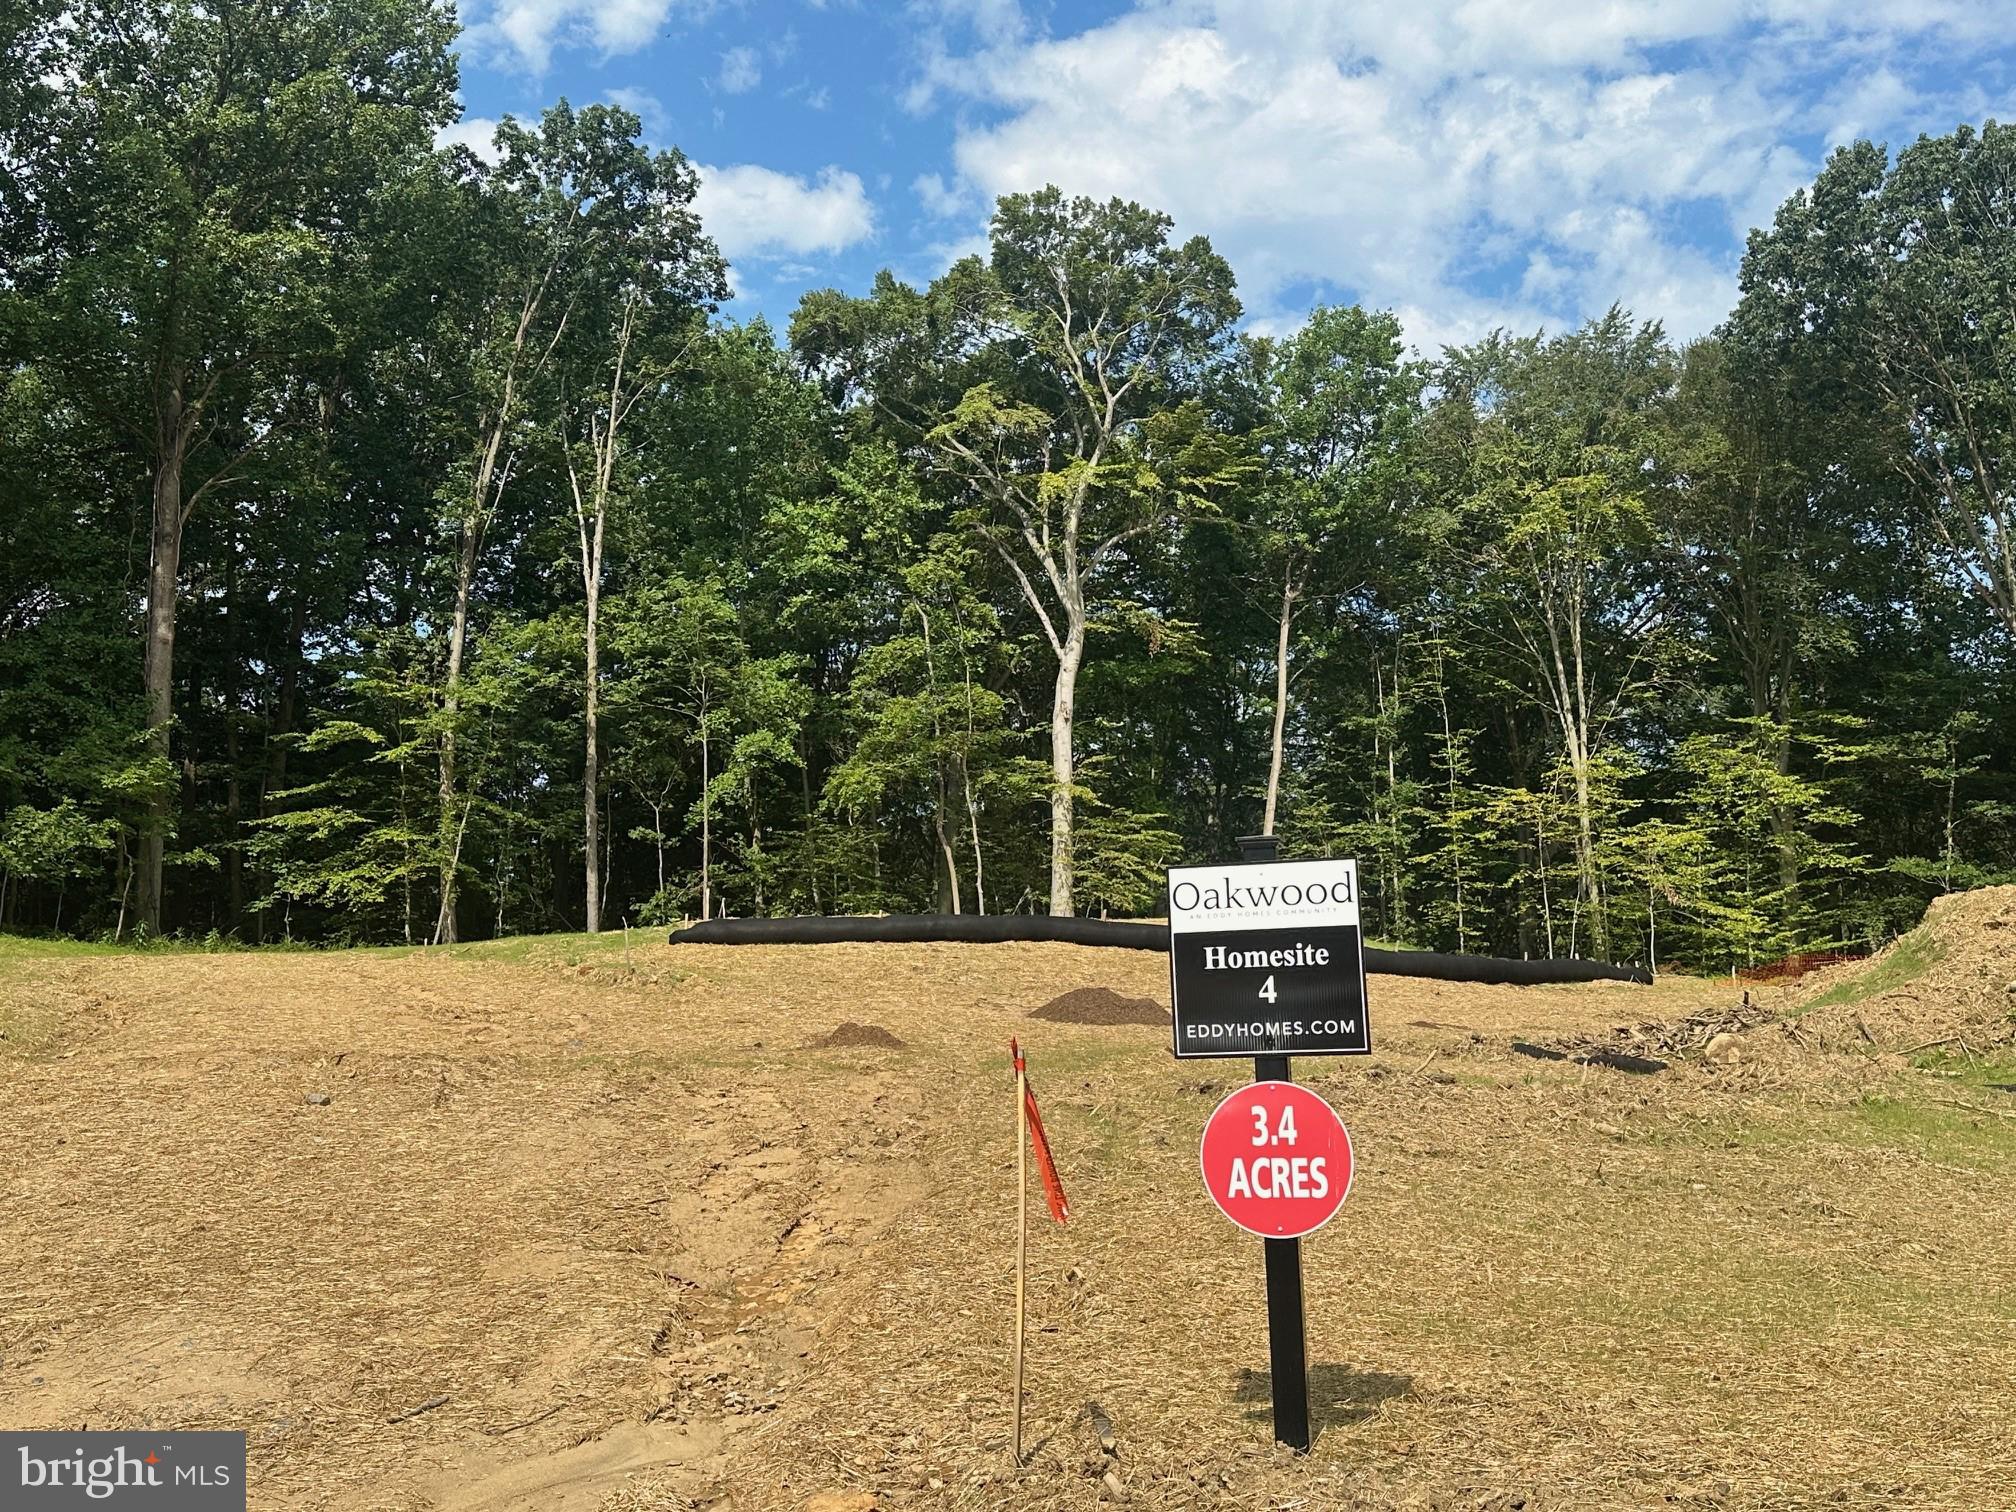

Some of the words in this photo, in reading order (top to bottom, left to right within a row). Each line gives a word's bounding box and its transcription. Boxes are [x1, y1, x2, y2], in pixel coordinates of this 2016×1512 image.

[1173, 871, 1354, 911] Oakwood
[1276, 907, 1338, 916] COMMUNITY
[1203, 943, 1330, 970] Homesite
[1258, 975, 1278, 1004] 4
[1186, 1020, 1355, 1039] EDDYHOMES.COM
[1251, 1105, 1298, 1147] 3.4
[1228, 1157, 1329, 1199] ACRES
